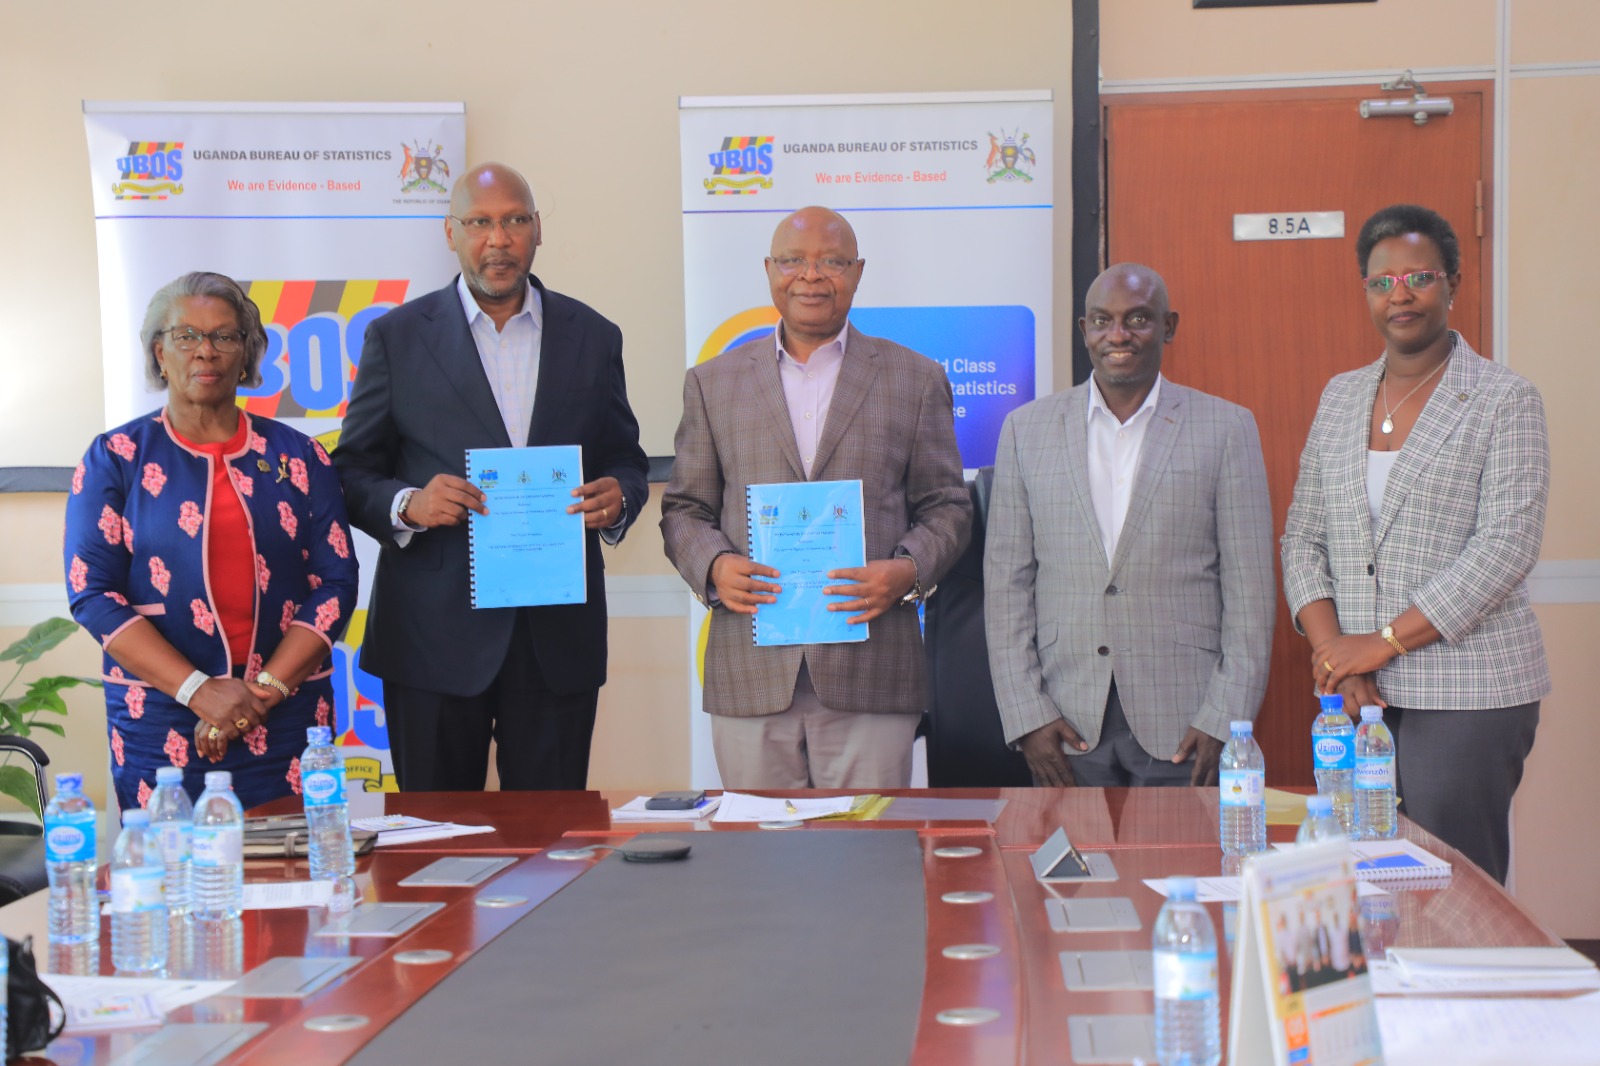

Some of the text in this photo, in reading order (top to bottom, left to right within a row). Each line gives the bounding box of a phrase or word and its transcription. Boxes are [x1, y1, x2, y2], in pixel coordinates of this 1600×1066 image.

[783, 140, 978, 154] UGANDA BUREAU OF STATISTICS
[193, 150, 392, 161] UGANDA BUREAU OF STATISTICS
[708, 144, 773, 175] UBOS
[116, 149, 183, 181] UBOS
[227, 180, 245, 191] We
[247, 182, 265, 191] are
[267, 179, 318, 191] Evidence
[326, 179, 362, 191] Based
[815, 172, 833, 184] We
[834, 174, 851, 183] are
[854, 171, 904, 184] Evidence
[912, 170, 947, 183] Based
[1269, 217, 1311, 235] 8.5A
[953, 358, 997, 374] Class
[951, 380, 1017, 396] tatistics
